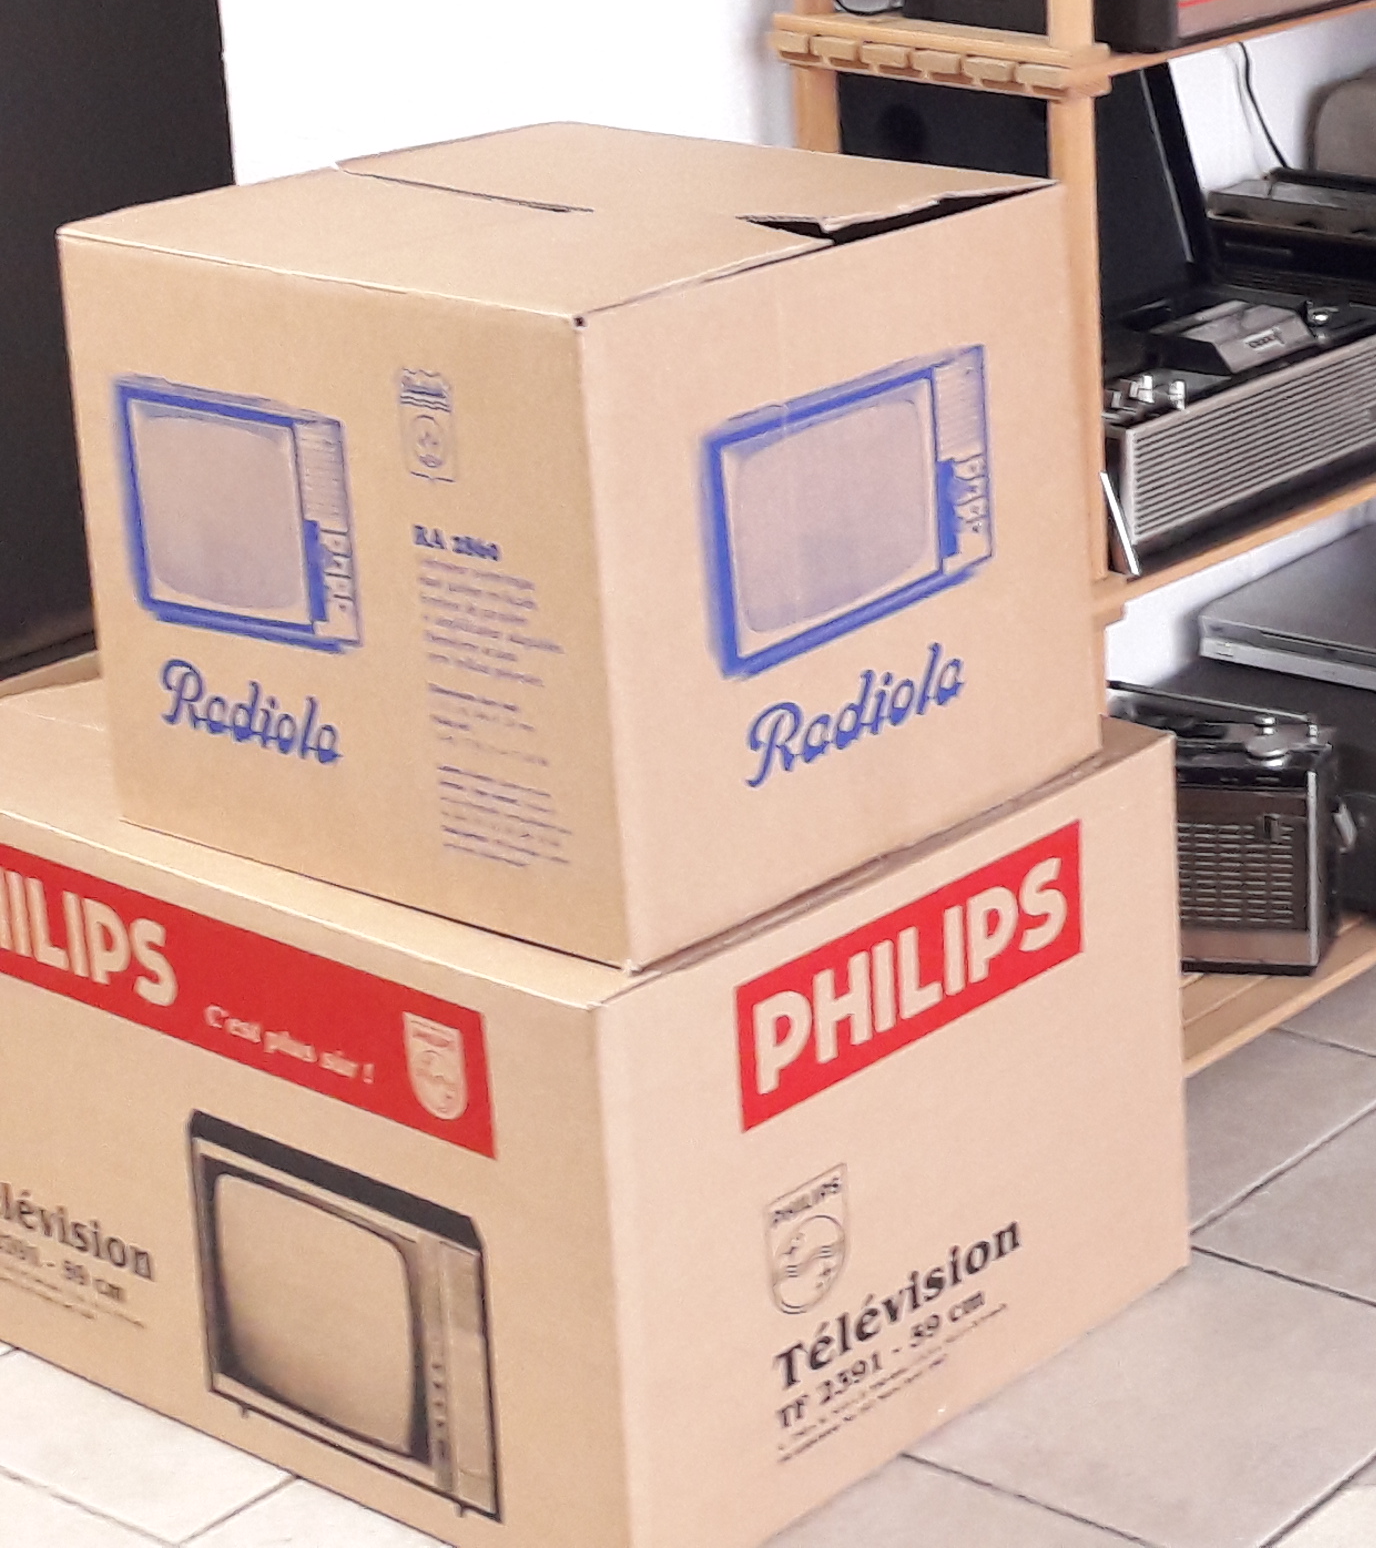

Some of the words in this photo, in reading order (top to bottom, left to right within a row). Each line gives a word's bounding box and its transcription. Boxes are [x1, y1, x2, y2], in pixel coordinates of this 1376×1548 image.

[160, 657, 343, 766] Radiola
[746, 642, 965, 789] Radiola
[752, 856, 1068, 1095] PHILIPS
[361, 1062, 375, 1084] !
[0, 1181, 155, 1282] lévision
[772, 1220, 1021, 1391] Télévision
